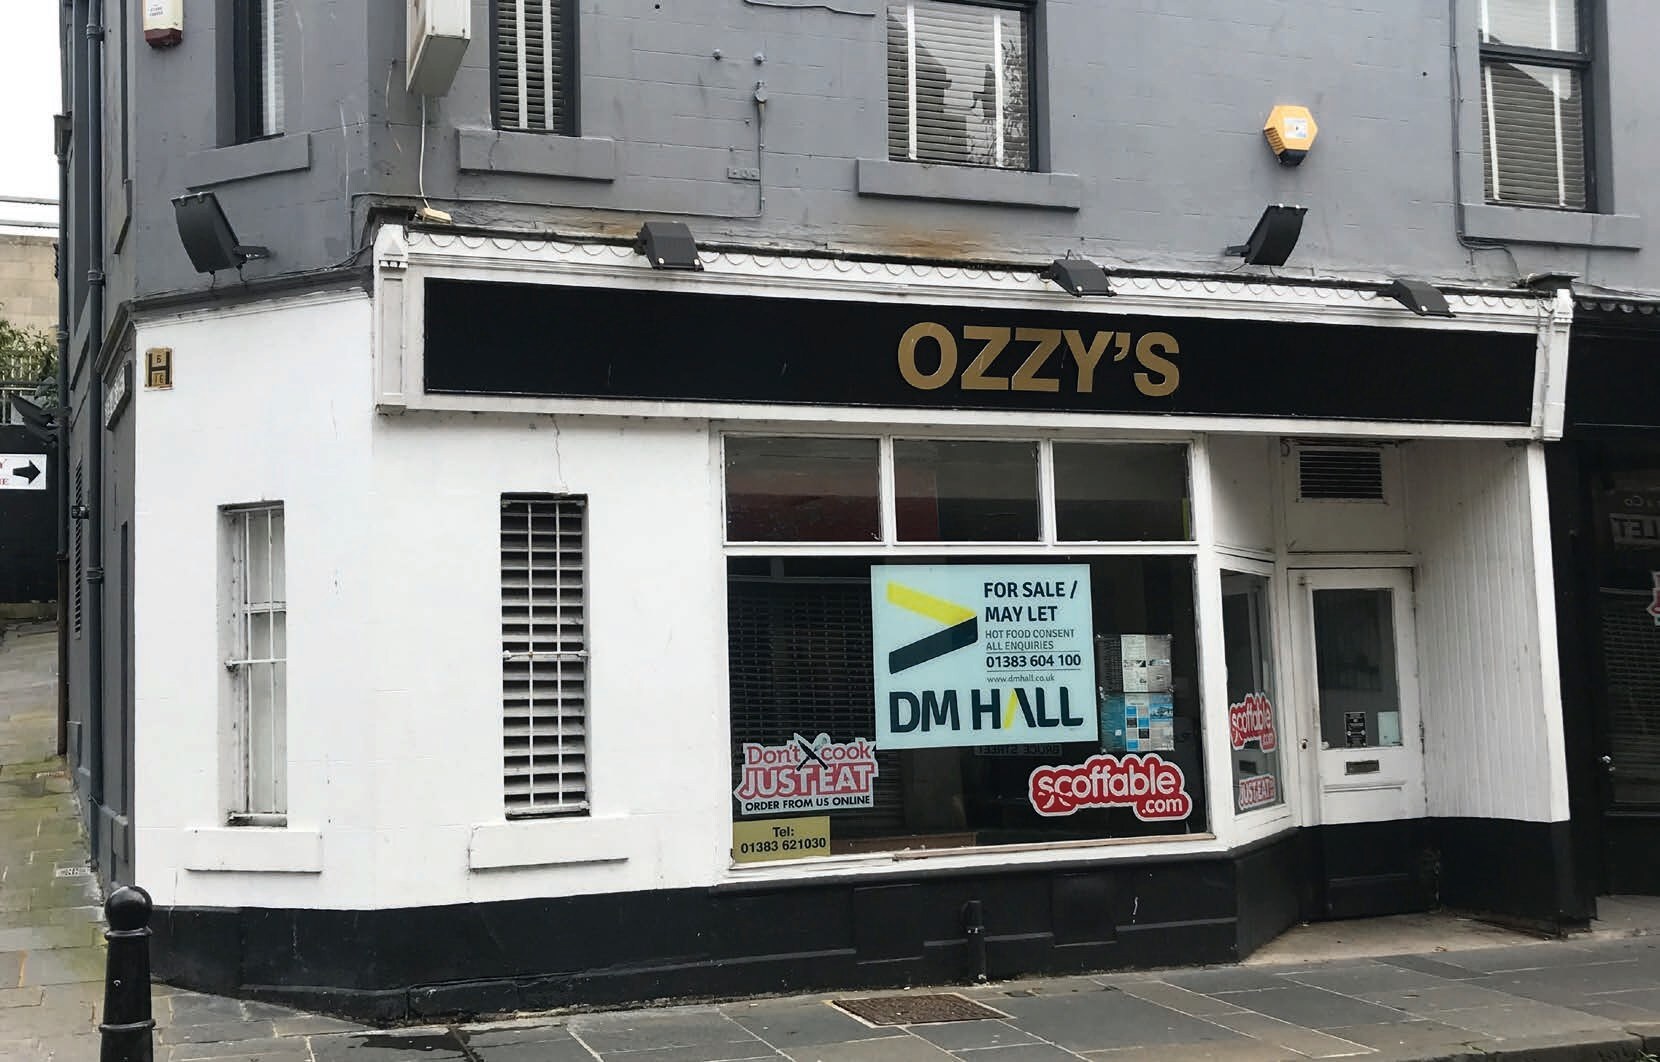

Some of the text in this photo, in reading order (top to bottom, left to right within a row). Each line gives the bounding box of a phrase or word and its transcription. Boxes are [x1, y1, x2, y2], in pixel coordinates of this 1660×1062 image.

[898, 322, 1180, 397] OZZY'S
[984, 580, 1078, 599] FOR SALE /
[985, 606, 1058, 622] MAY LET
[985, 629, 1075, 639] HOT FOOD CONSENT
[986, 641, 1054, 650] ALL ENQUIRIES
[986, 654, 1082, 668] 01383 604 100
[987, 673, 1055, 683] www.dmhall.co.uk
[889, 690, 960, 733] DM
[971, 687, 1084, 731] HALL
[1231, 701, 1271, 734] scoffable
[746, 742, 871, 765] Don't cook
[742, 764, 872, 795] JUST EAT
[1038, 763, 1176, 799] scoffable
[745, 795, 870, 812] ORDER FROM US ONLINE
[1141, 798, 1183, 814] .com
[772, 826, 795, 837] Tel:
[740, 838, 826, 854] 01383 621030
